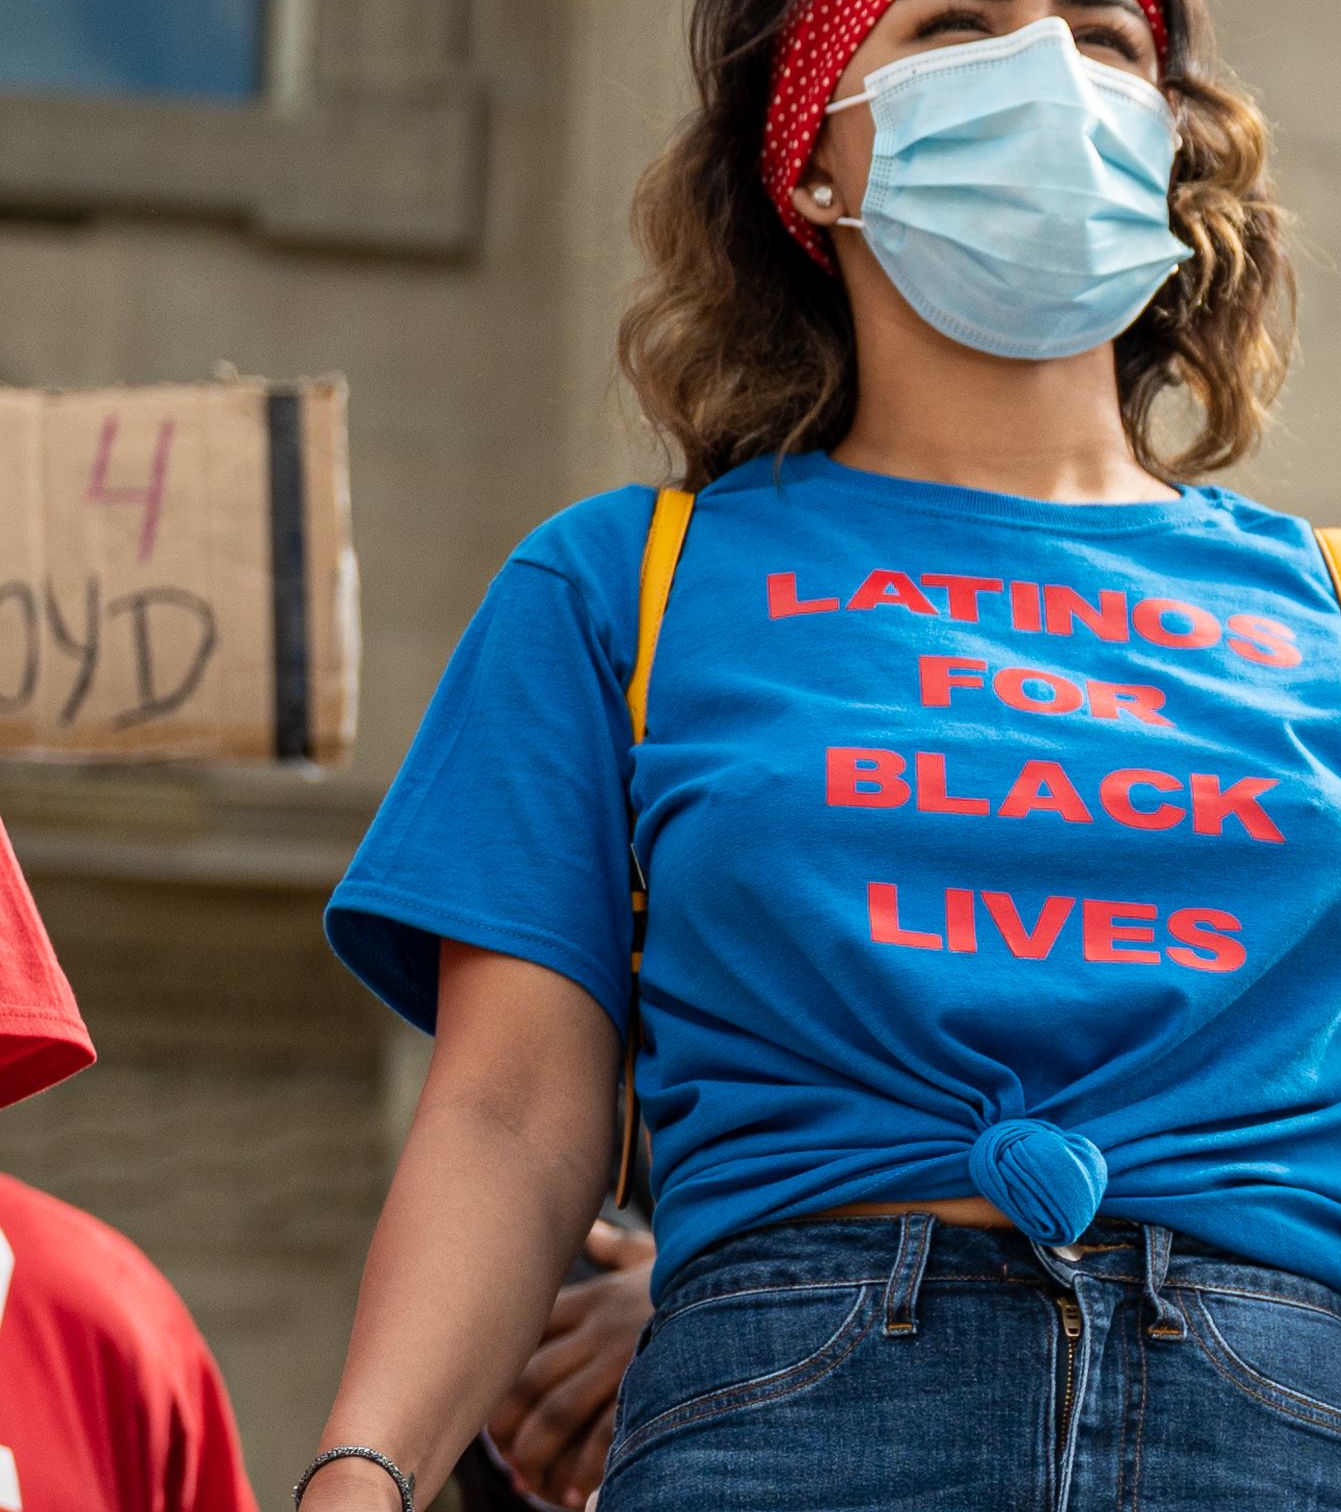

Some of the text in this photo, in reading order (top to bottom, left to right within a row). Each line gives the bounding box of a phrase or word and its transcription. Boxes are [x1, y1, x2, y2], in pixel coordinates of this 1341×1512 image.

[85, 414, 176, 565] 4
[767, 570, 1302, 668] LATINOS
[919, 655, 1176, 728] FOR
[826, 747, 1286, 843] BLACK
[868, 882, 1247, 973] LIVES
